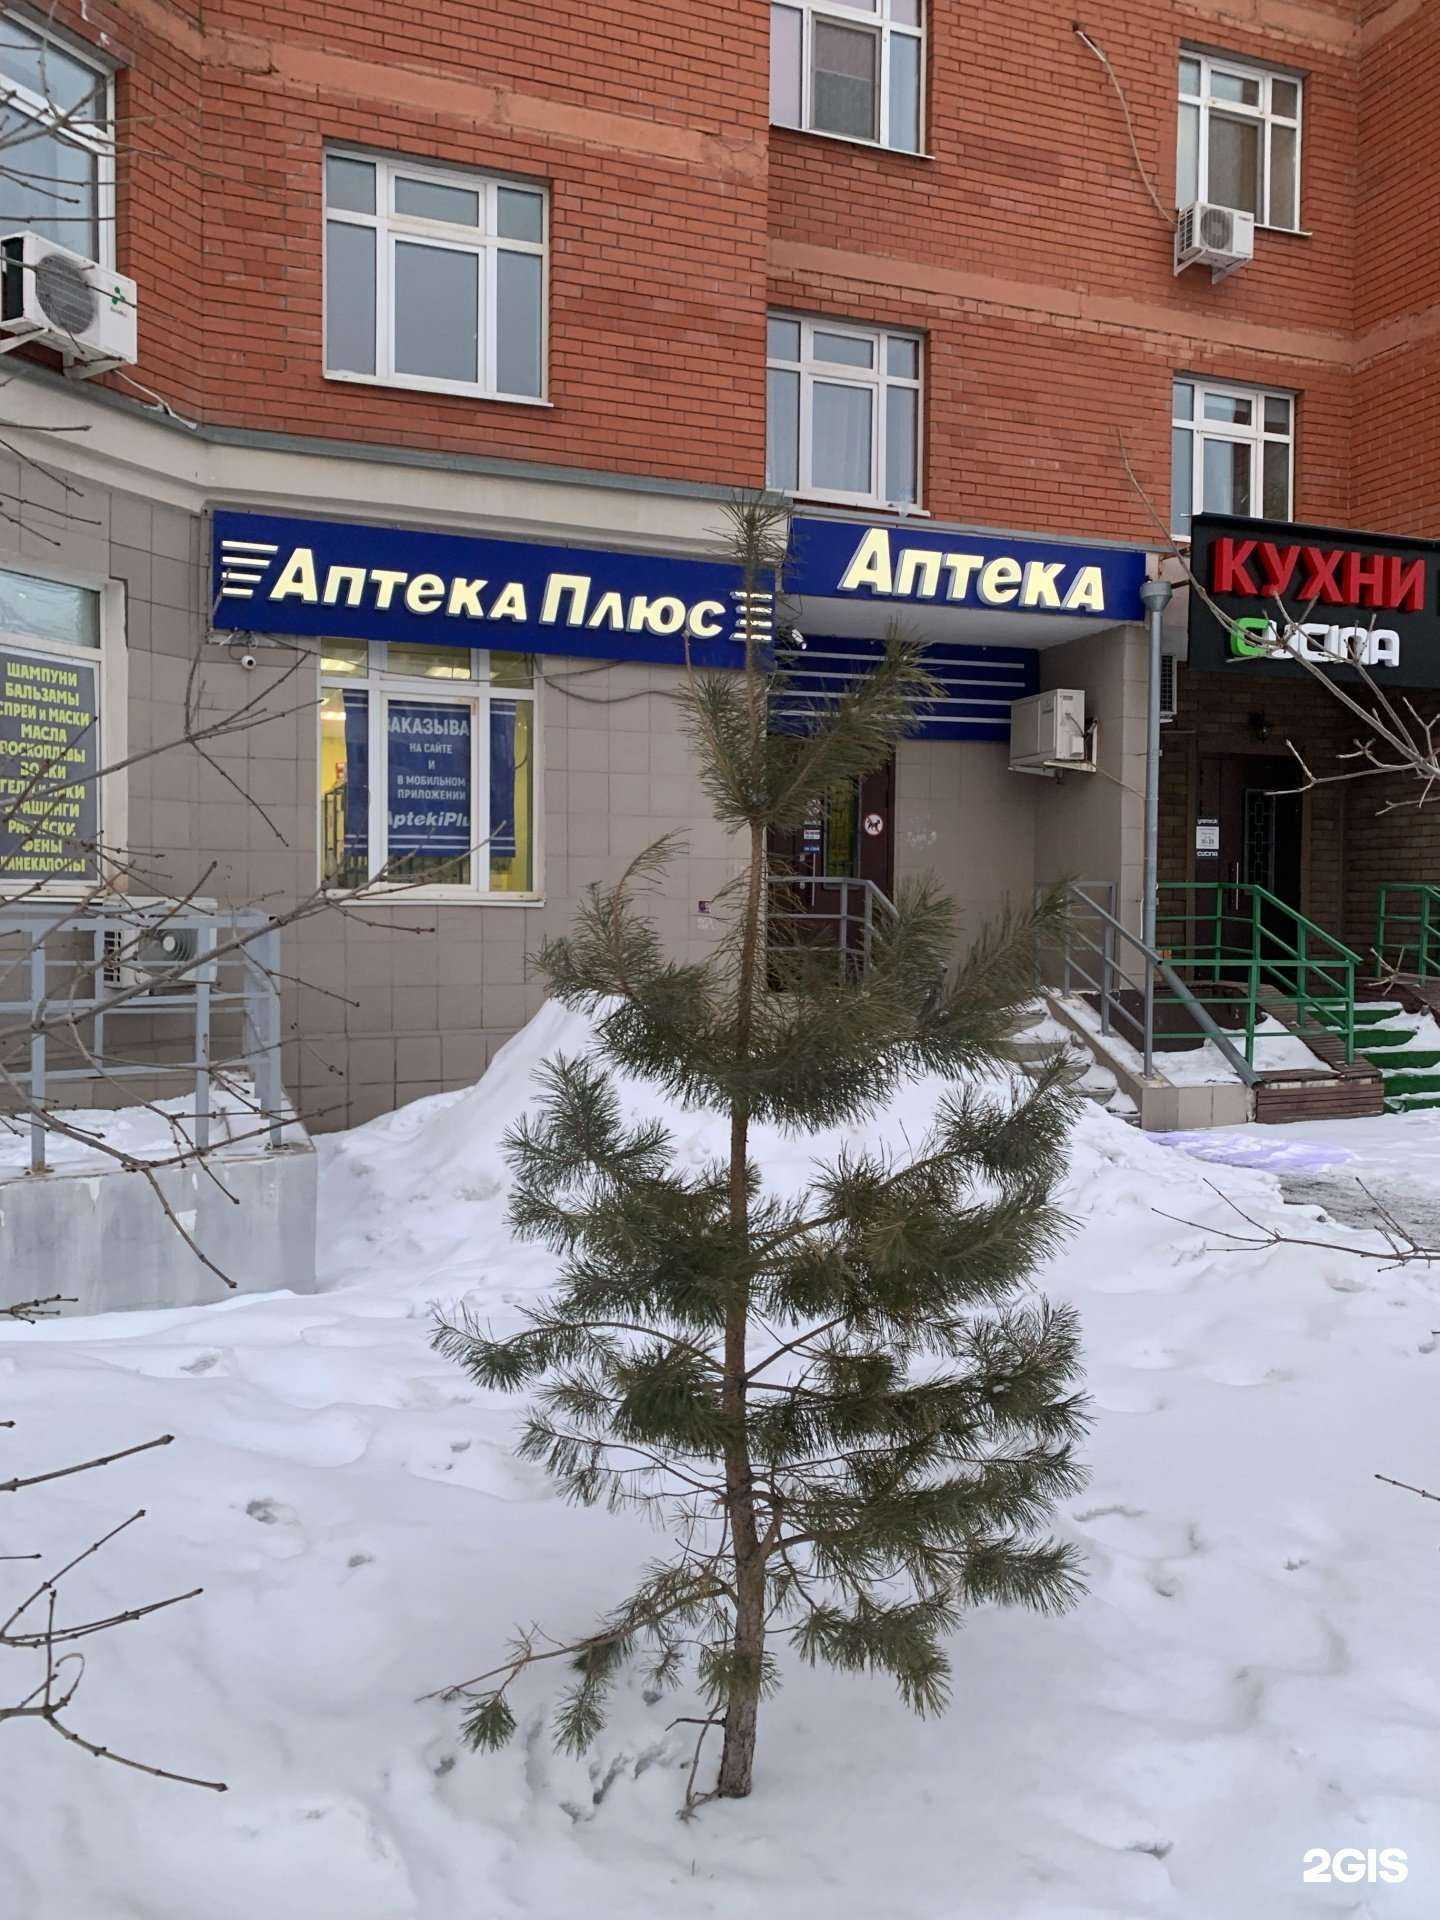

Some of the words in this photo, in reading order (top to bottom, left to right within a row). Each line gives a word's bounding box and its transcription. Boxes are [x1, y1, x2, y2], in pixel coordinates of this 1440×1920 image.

[1213, 536, 1427, 612] КУХНИ
[539, 572, 726, 639] Плюс
[7, 662, 78, 687] ШАМПУНИ
[5, 682, 80, 707] БАЛЬЗАМЫ
[48, 708, 90, 727] МАСКИ
[388, 716, 471, 737] АКАЗЫВА
[20, 723, 68, 743] МАСЛА
[409, 743, 422, 753] НА
[20, 761, 67, 779] ВОКИ
[397, 775, 404, 785] В
[405, 775, 466, 787] МОБИЛЬНОМ
[398, 789, 467, 801] ПРИЛОЖЕНИИ
[4, 799, 80, 818] АШИНГИ
